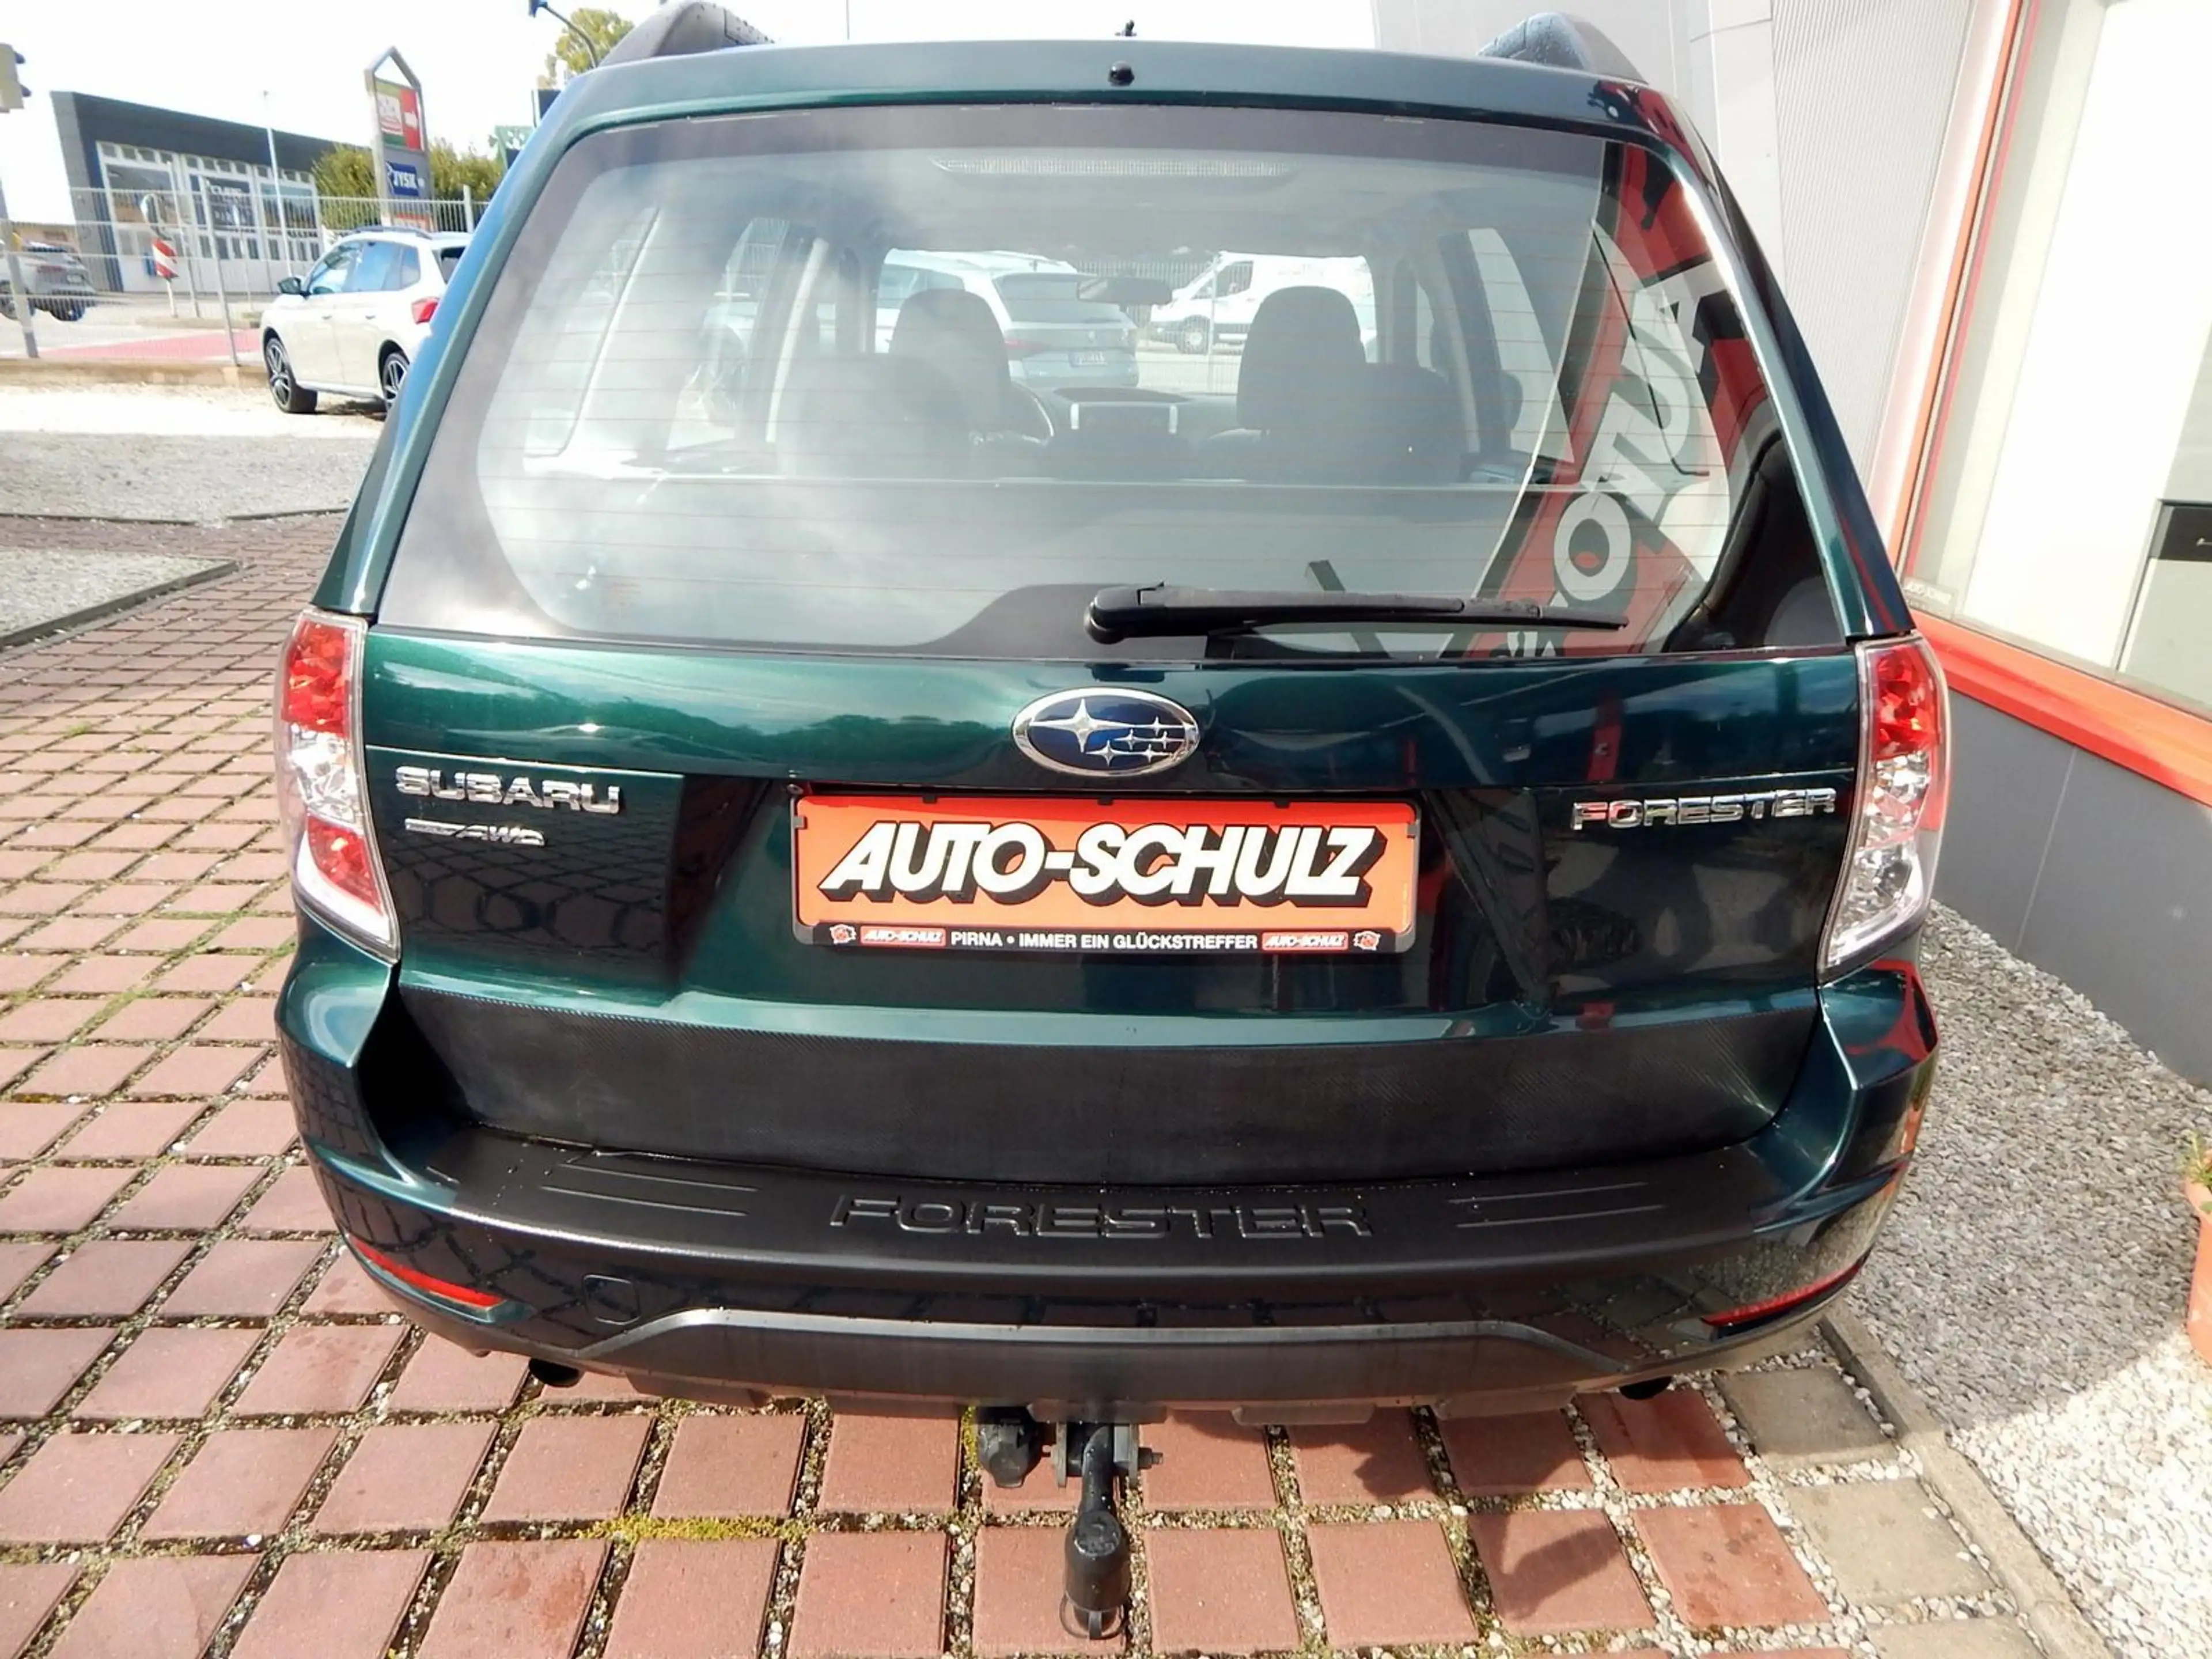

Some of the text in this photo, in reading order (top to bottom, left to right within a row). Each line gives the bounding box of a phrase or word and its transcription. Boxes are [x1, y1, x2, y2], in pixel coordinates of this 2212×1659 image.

[396, 766, 620, 814] SUBARU
[1571, 787, 1837, 830] FORESTER
[454, 824, 546, 846] AWD
[817, 820, 1388, 908] AUTO-SCHULZ
[951, 931, 1257, 950] PIRNA IMMER EIN GLÜCKSTREFFER
[830, 1194, 1373, 1238] FORESTER
